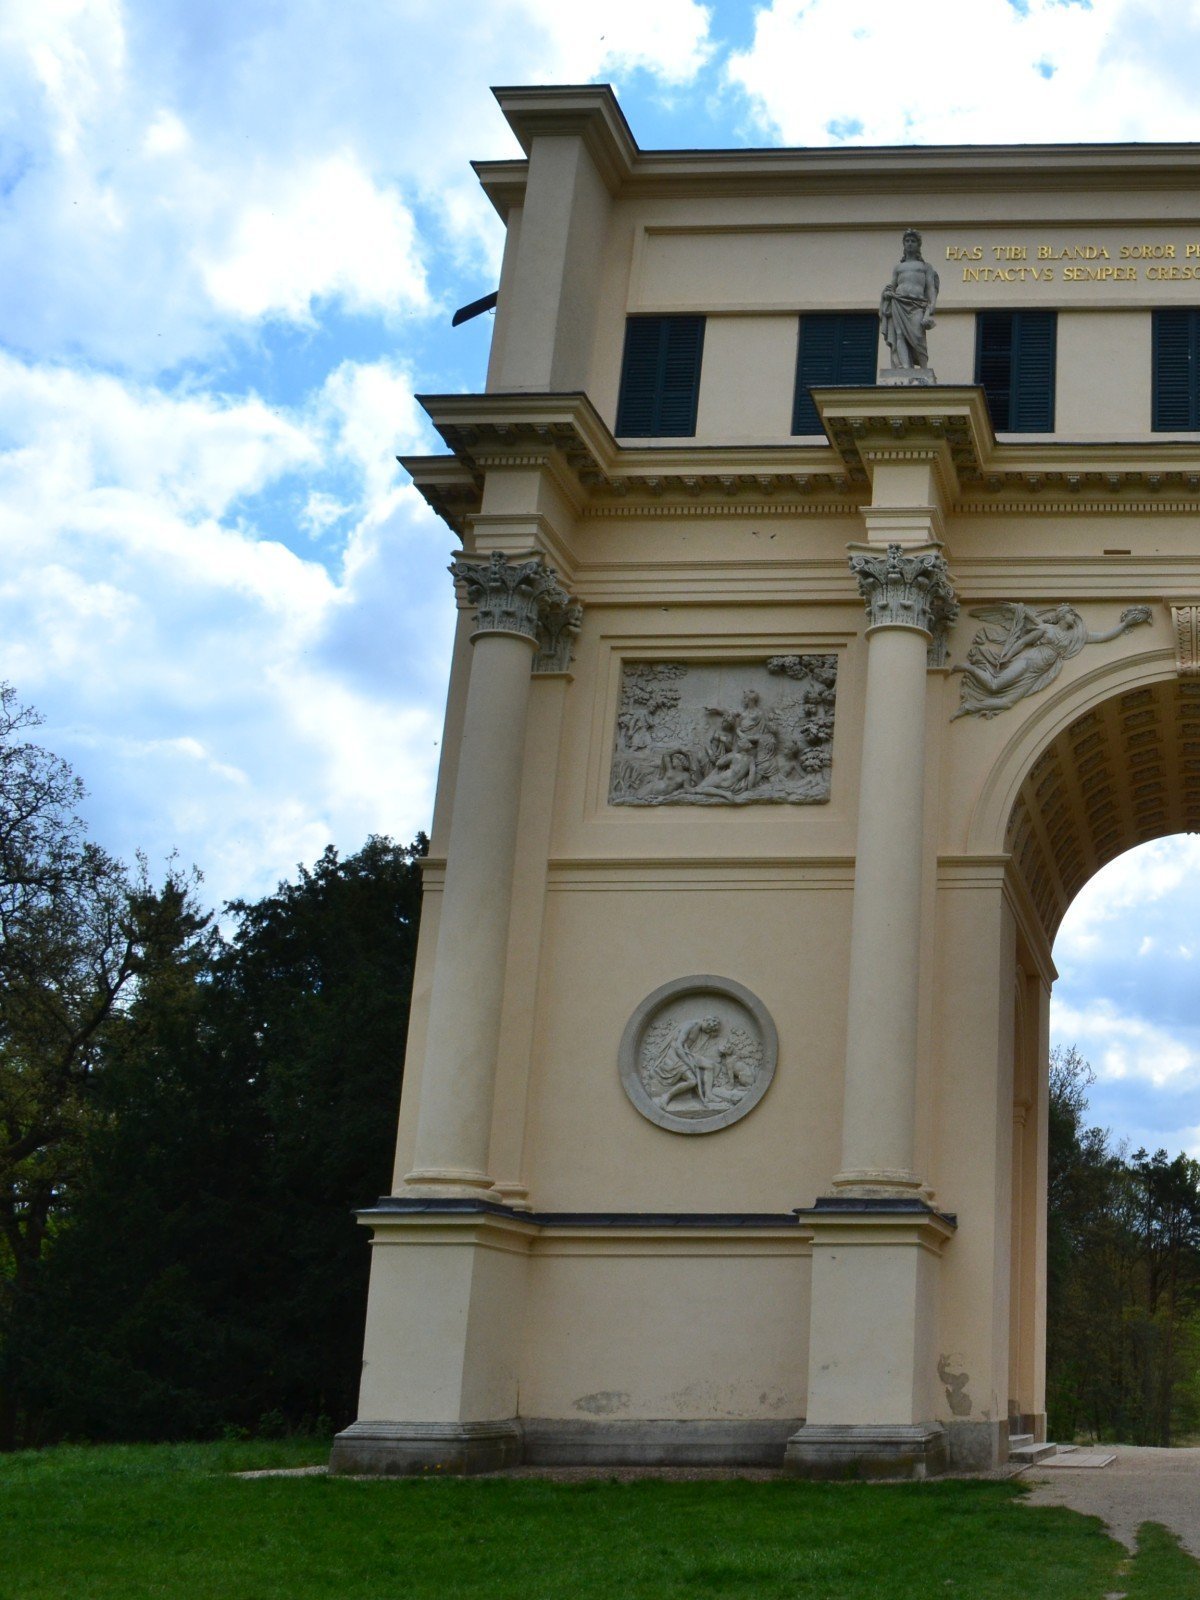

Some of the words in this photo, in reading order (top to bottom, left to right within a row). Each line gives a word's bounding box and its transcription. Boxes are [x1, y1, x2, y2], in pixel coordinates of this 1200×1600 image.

[946, 245, 983, 260] HAS
[992, 245, 1027, 260] TIBI
[1037, 245, 1110, 260] BLANDA
[1119, 245, 1175, 260] SOROR
[962, 267, 1054, 282] INTACTVS
[1062, 267, 1137, 281] SEMPER
